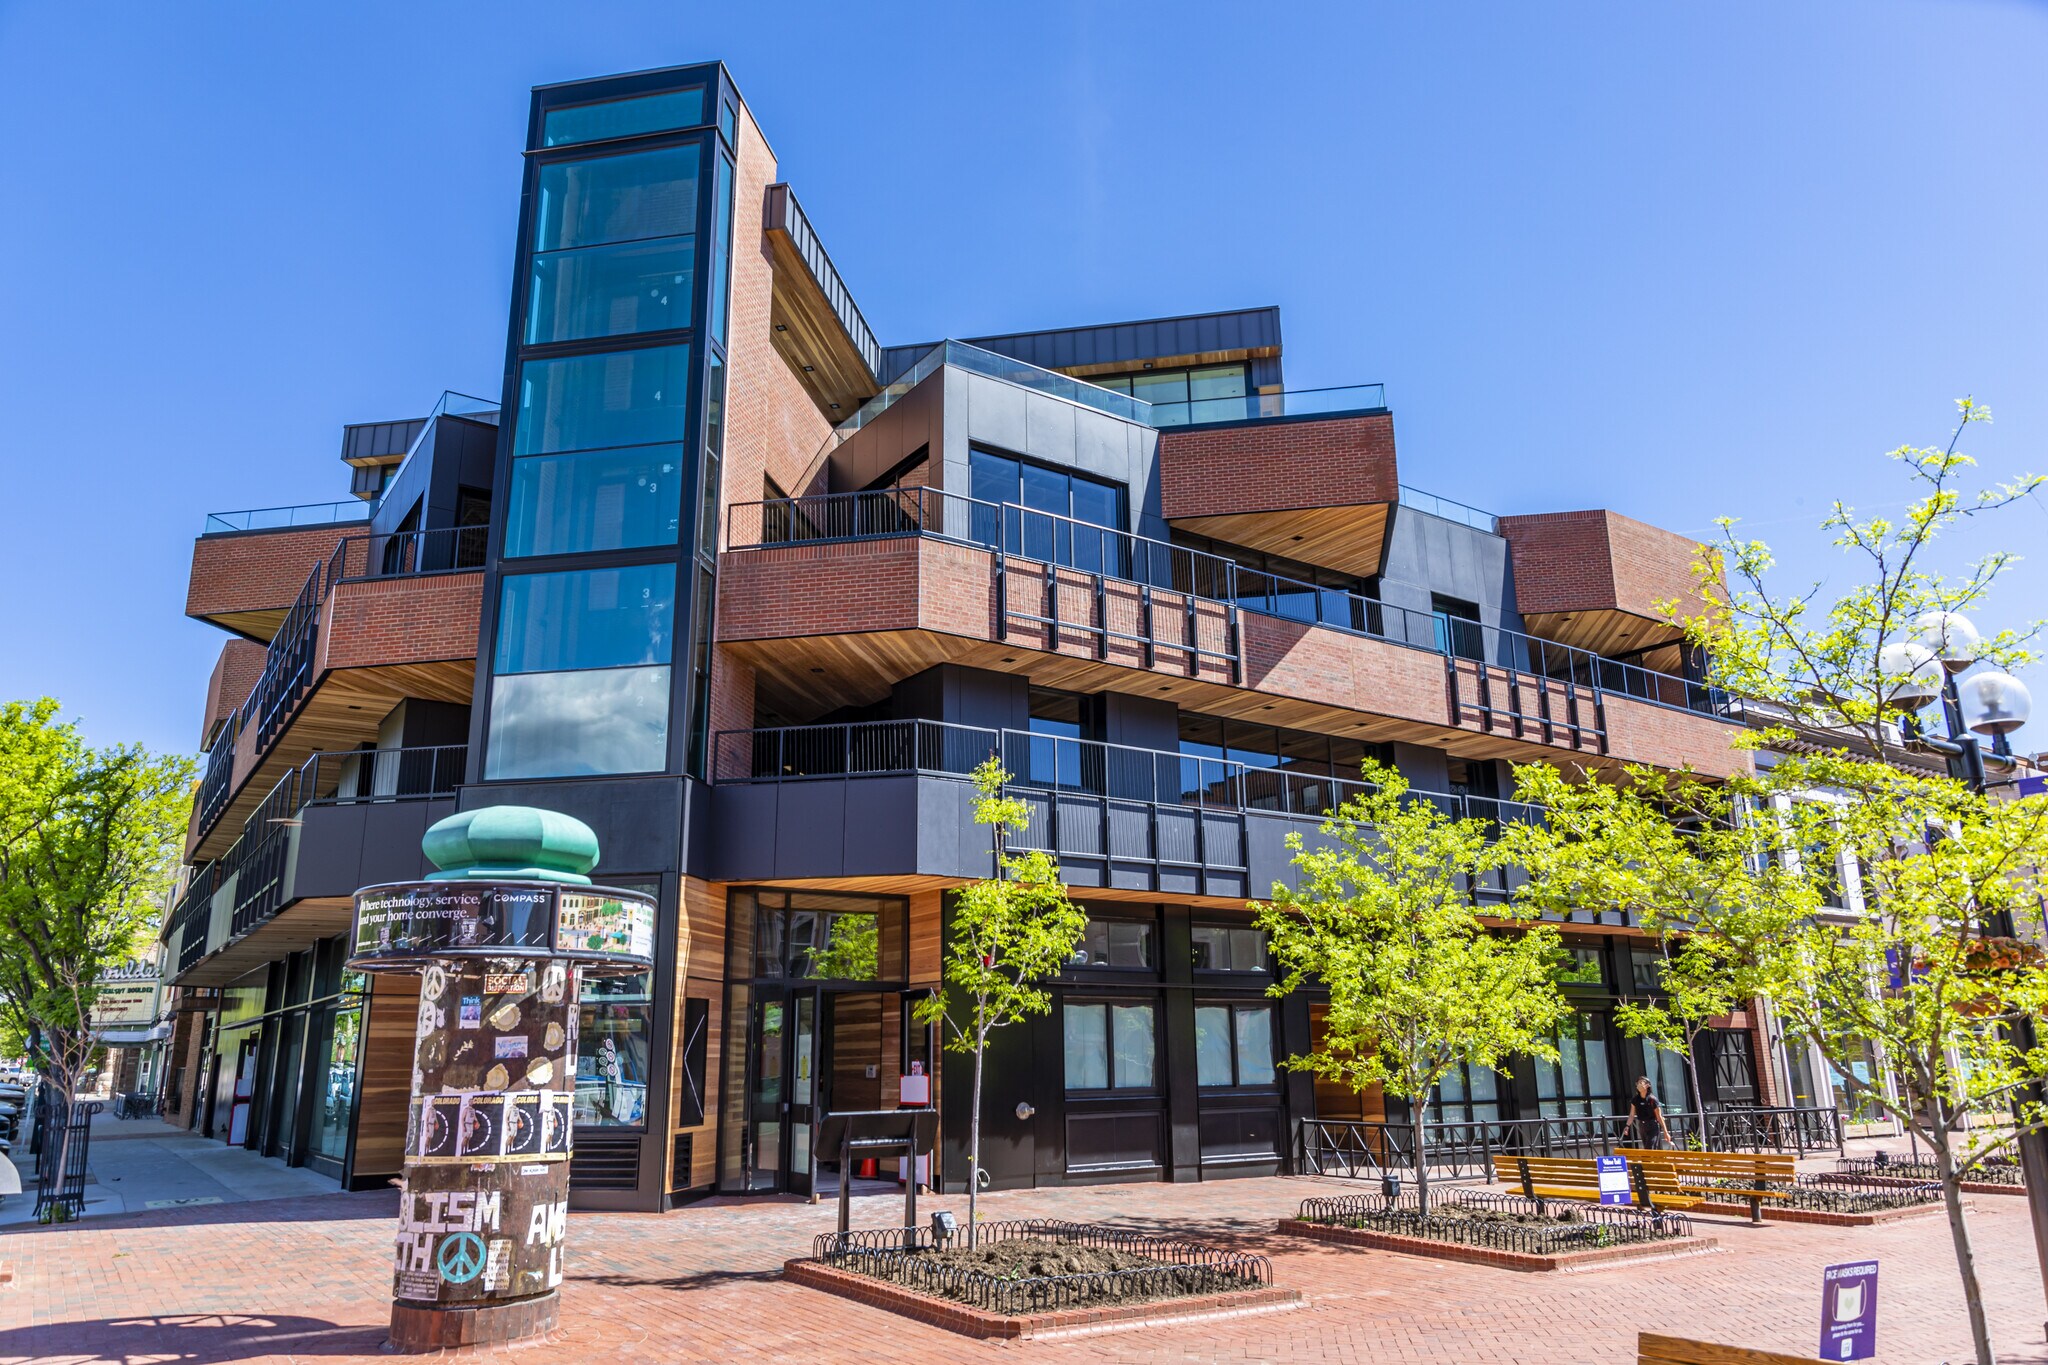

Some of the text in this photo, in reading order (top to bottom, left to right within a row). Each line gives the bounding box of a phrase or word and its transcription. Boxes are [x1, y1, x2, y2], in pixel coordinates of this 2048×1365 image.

[661, 296, 668, 305] 4
[655, 391, 661, 400] 4
[650, 483, 657, 493] 3
[643, 588, 650, 598] 3
[380, 895, 434, 909] technology,
[435, 893, 481, 905] service,
[494, 894, 545, 903] COMPASS
[369, 914, 386, 926] your
[387, 910, 414, 921] home
[415, 907, 470, 920] converge.
[96, 959, 161, 979] oulder
[487, 976, 524, 985] SOCIAL
[462, 996, 480, 1005] Think
[434, 1096, 461, 1105] COLORADO
[472, 1096, 504, 1105] COLORADO
[1826, 1270, 1838, 1280] FACE
[1853, 1265, 1876, 1276] REQUIRED
